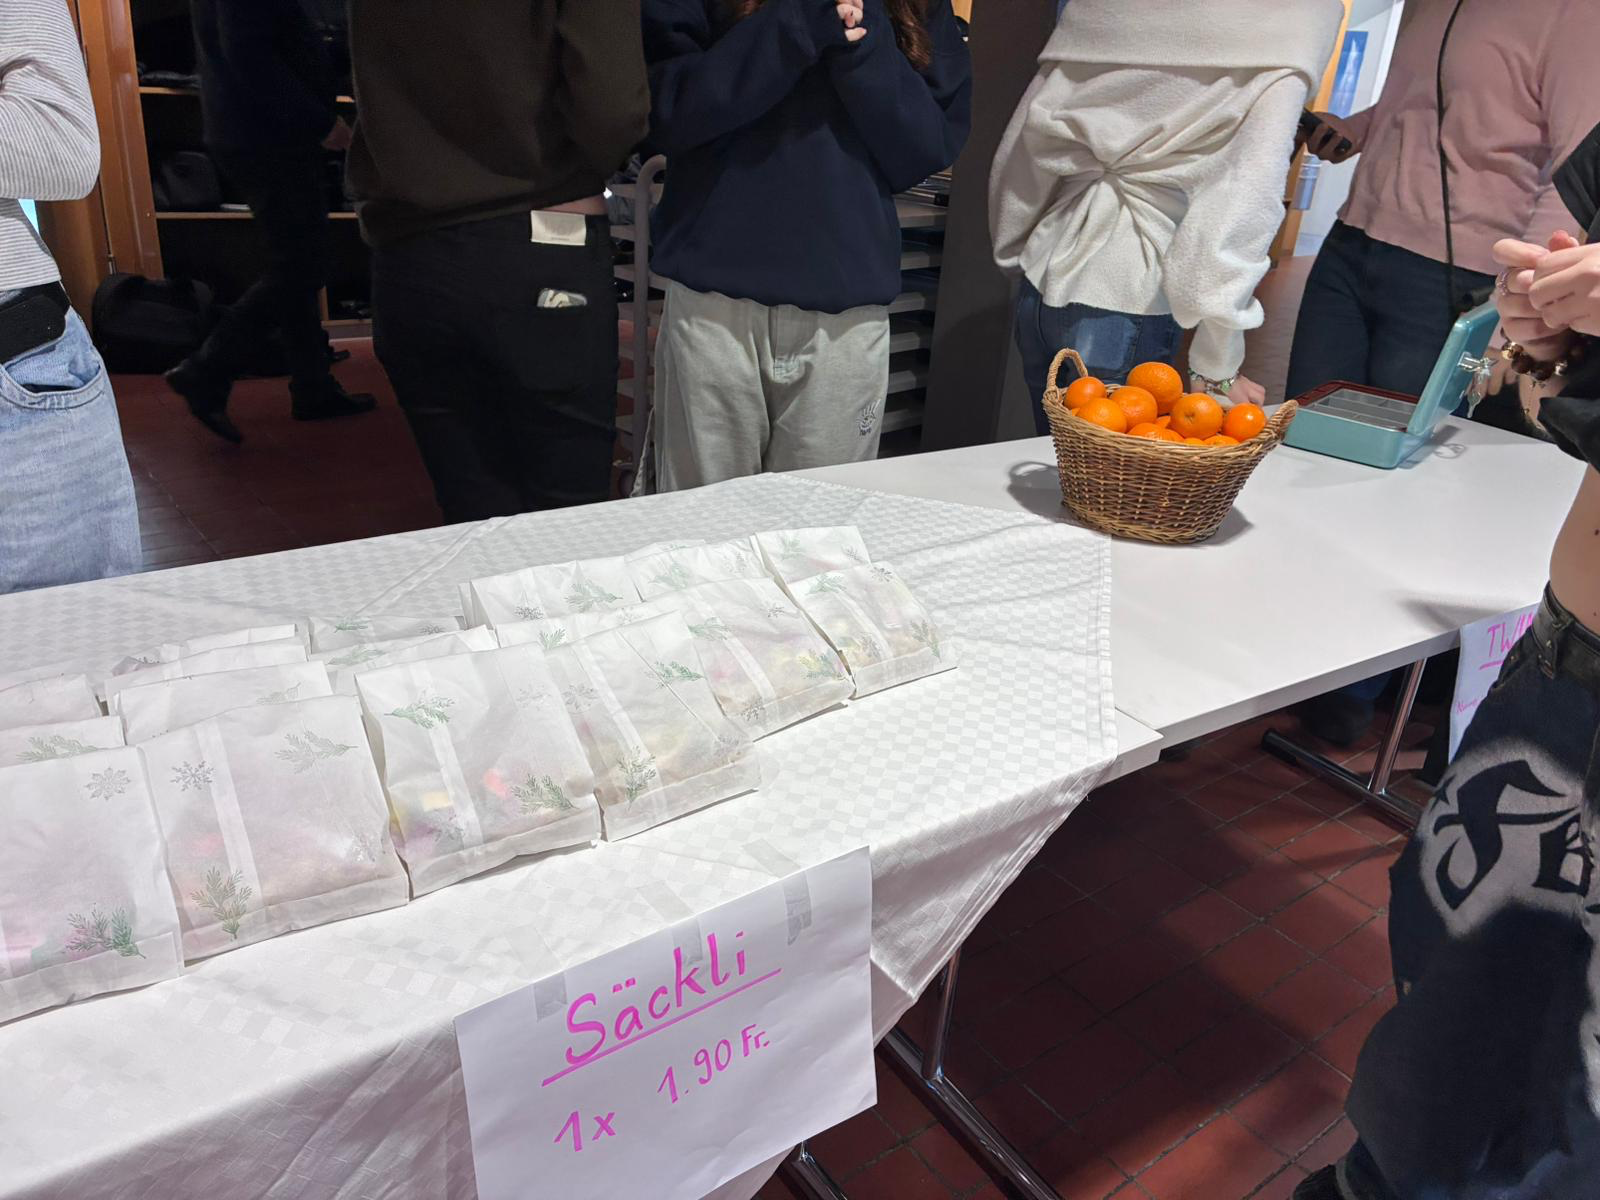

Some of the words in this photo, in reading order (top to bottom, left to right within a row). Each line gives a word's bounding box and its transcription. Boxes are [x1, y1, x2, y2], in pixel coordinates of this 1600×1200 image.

[565, 931, 747, 1066] Säckli
[553, 1110, 617, 1153] 1x
[656, 1038, 734, 1105] 1.90
[740, 1023, 771, 1058] Fr.
